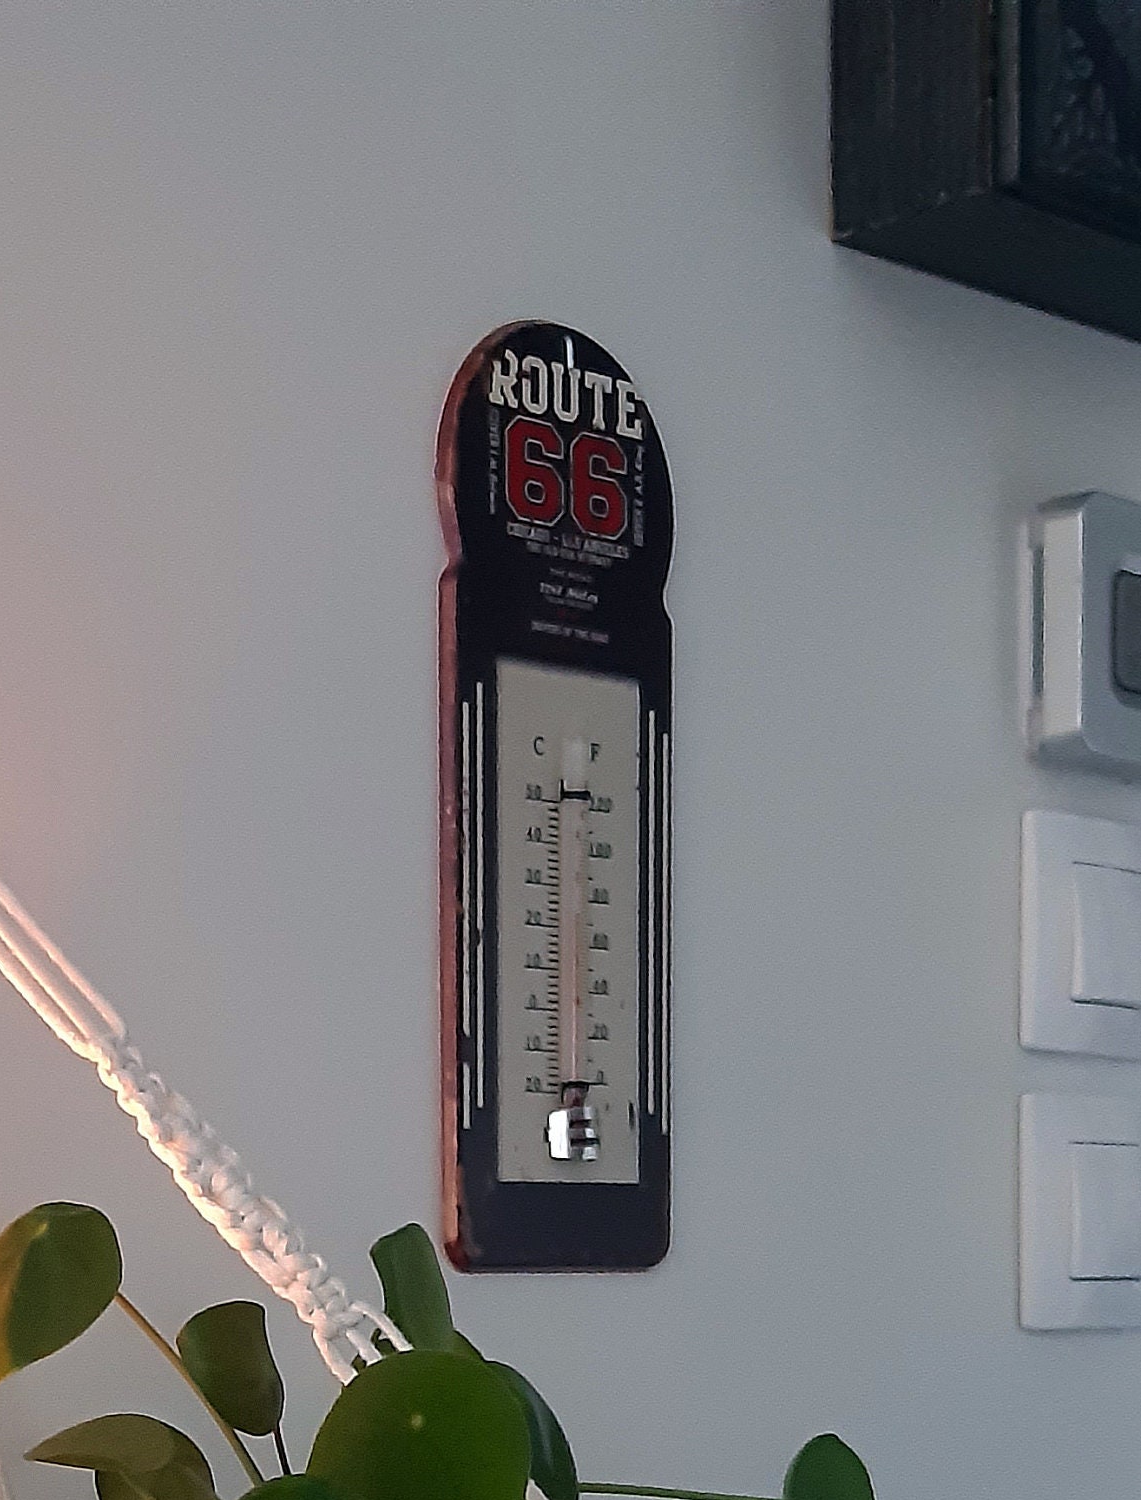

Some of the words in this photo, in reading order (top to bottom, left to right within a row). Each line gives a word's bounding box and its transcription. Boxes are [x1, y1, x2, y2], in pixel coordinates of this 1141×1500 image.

[489, 349, 644, 440] ROUTE
[505, 415, 628, 541] 66
[533, 736, 544, 756] C
[590, 742, 601, 761] F
[526, 910, 541, 926] 20
